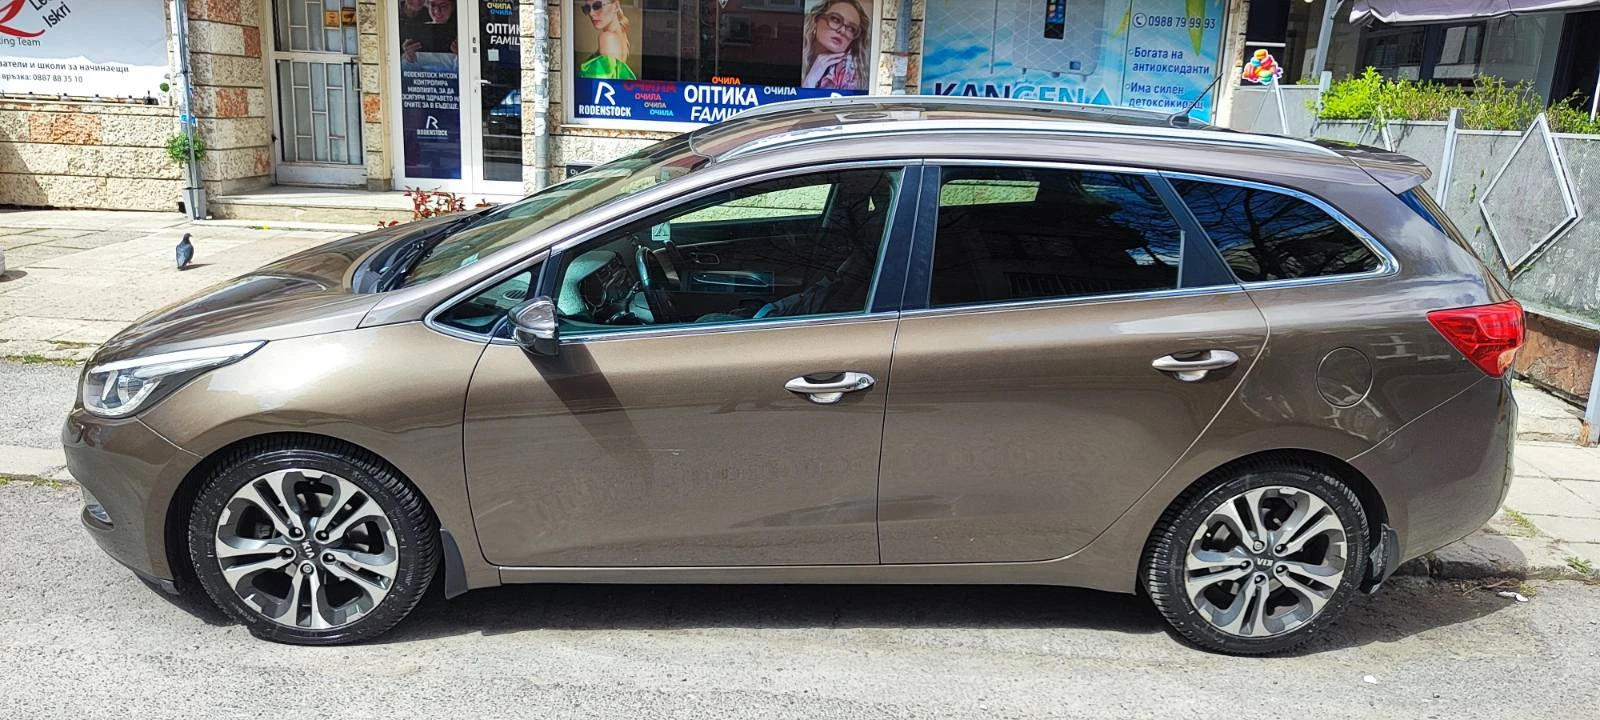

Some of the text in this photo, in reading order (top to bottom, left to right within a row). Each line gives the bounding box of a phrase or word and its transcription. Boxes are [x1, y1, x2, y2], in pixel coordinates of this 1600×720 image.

[42, 1, 71, 28] Iskri
[1148, 15, 1216, 29] 0988 79 99 93
[486, 23, 520, 35] ОПТИК
[0, 37, 41, 48] ing Team
[490, 36, 520, 45] FAMIL
[1134, 47, 1183, 59] Богата на
[80, 65, 129, 75] начинаещи
[1132, 63, 1210, 75] антиоксиданти
[33, 74, 51, 82] 0887
[53, 74, 62, 82] 88
[74, 75, 83, 83] 10
[712, 76, 741, 85] ОЧИЛА
[624, 80, 677, 92] ОЧИЛА
[763, 86, 797, 95] ОЧИЛА
[1130, 82, 1184, 94] Има силен
[635, 92, 662, 101] ОЧИЛА
[684, 84, 759, 106] ОПТИКА
[579, 104, 632, 117] RODENSTOCK
[650, 109, 674, 117] ОЧИЛА
[302, 541, 315, 559] KIA
[1257, 557, 1274, 567] KIA
